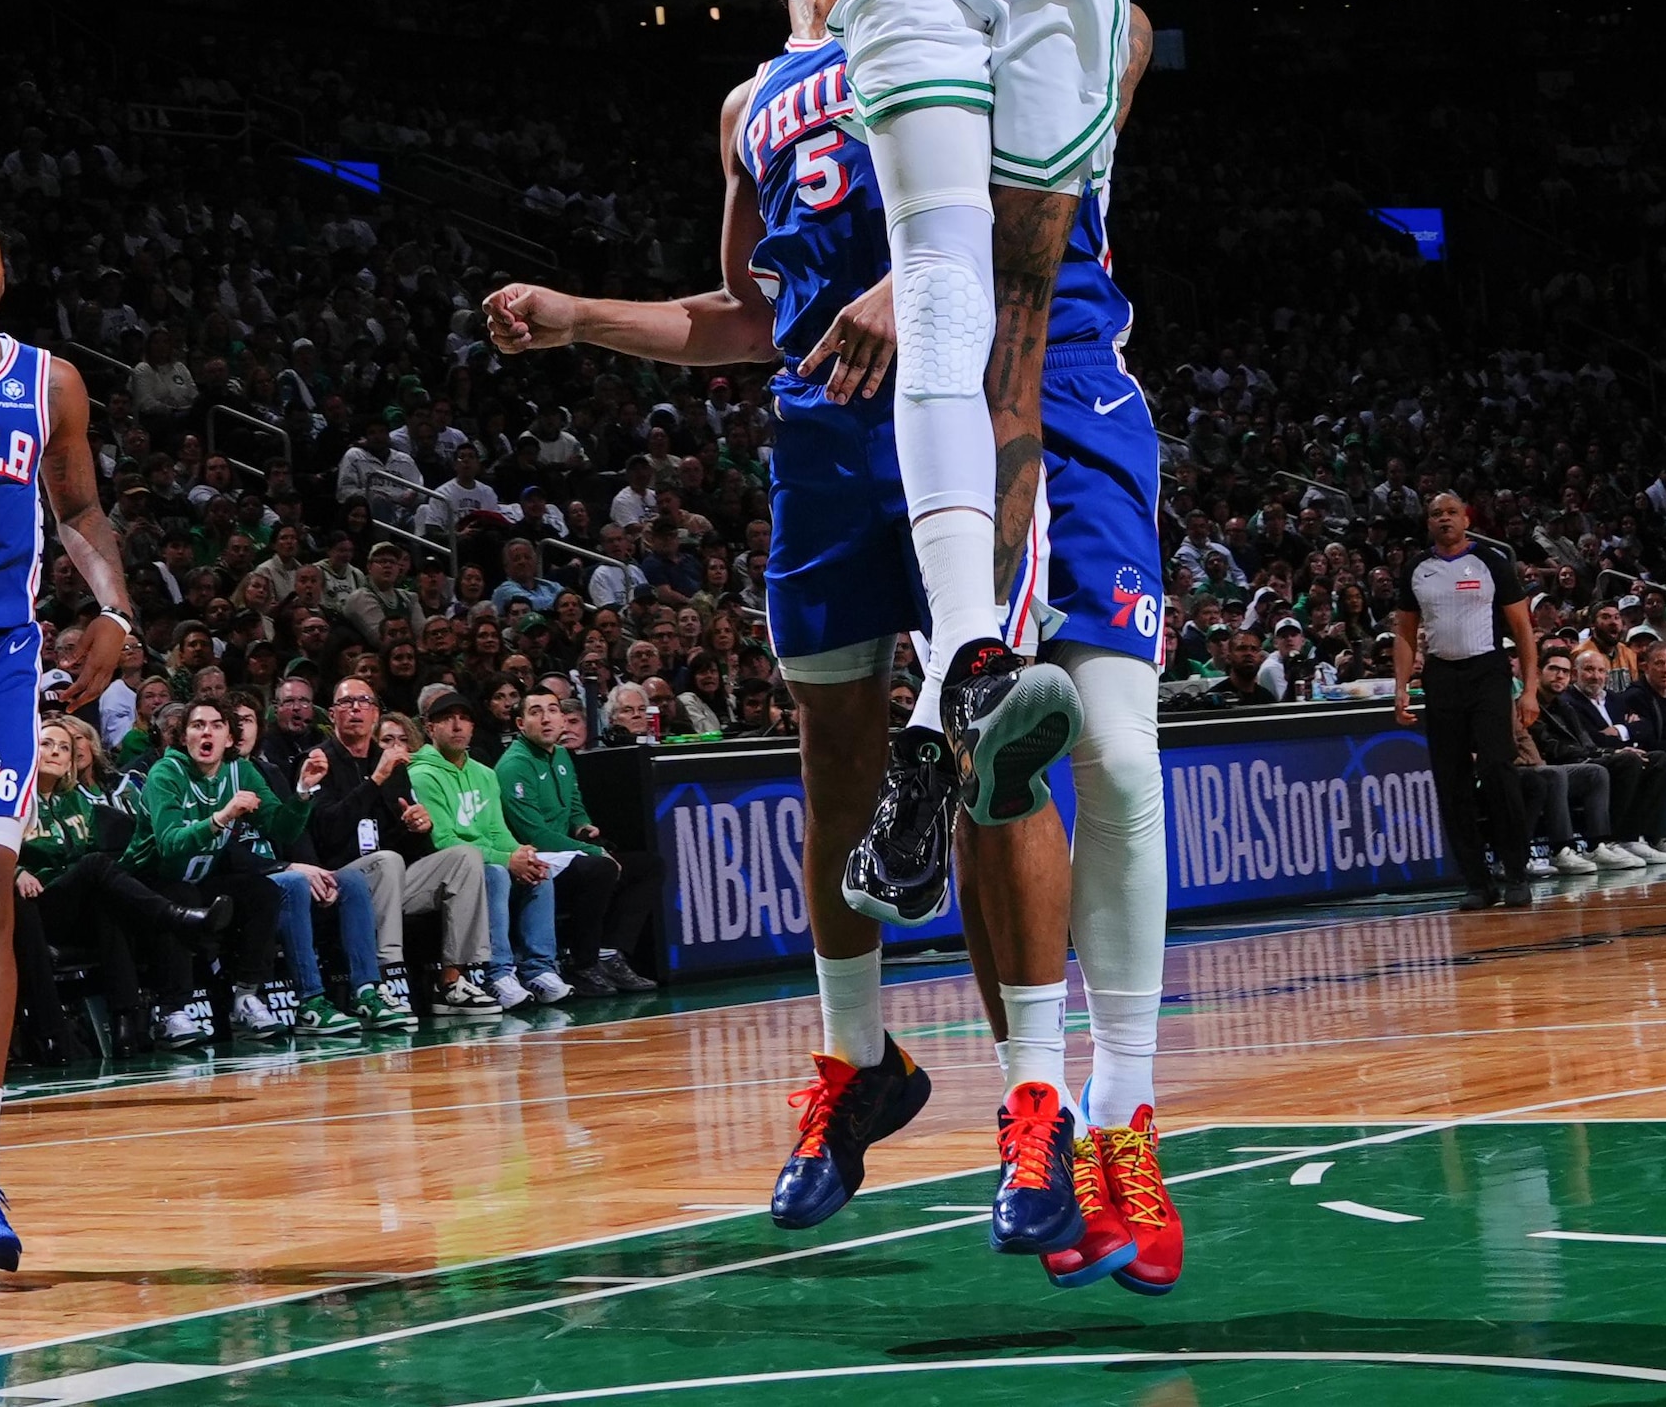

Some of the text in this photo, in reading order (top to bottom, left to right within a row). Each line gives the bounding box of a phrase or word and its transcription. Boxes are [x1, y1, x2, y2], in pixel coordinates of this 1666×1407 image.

[747, 62, 854, 183] PHIL
[794, 130, 850, 212] 5
[1110, 586, 1158, 638] 76
[1171, 759, 1443, 889] NBAStore.com
